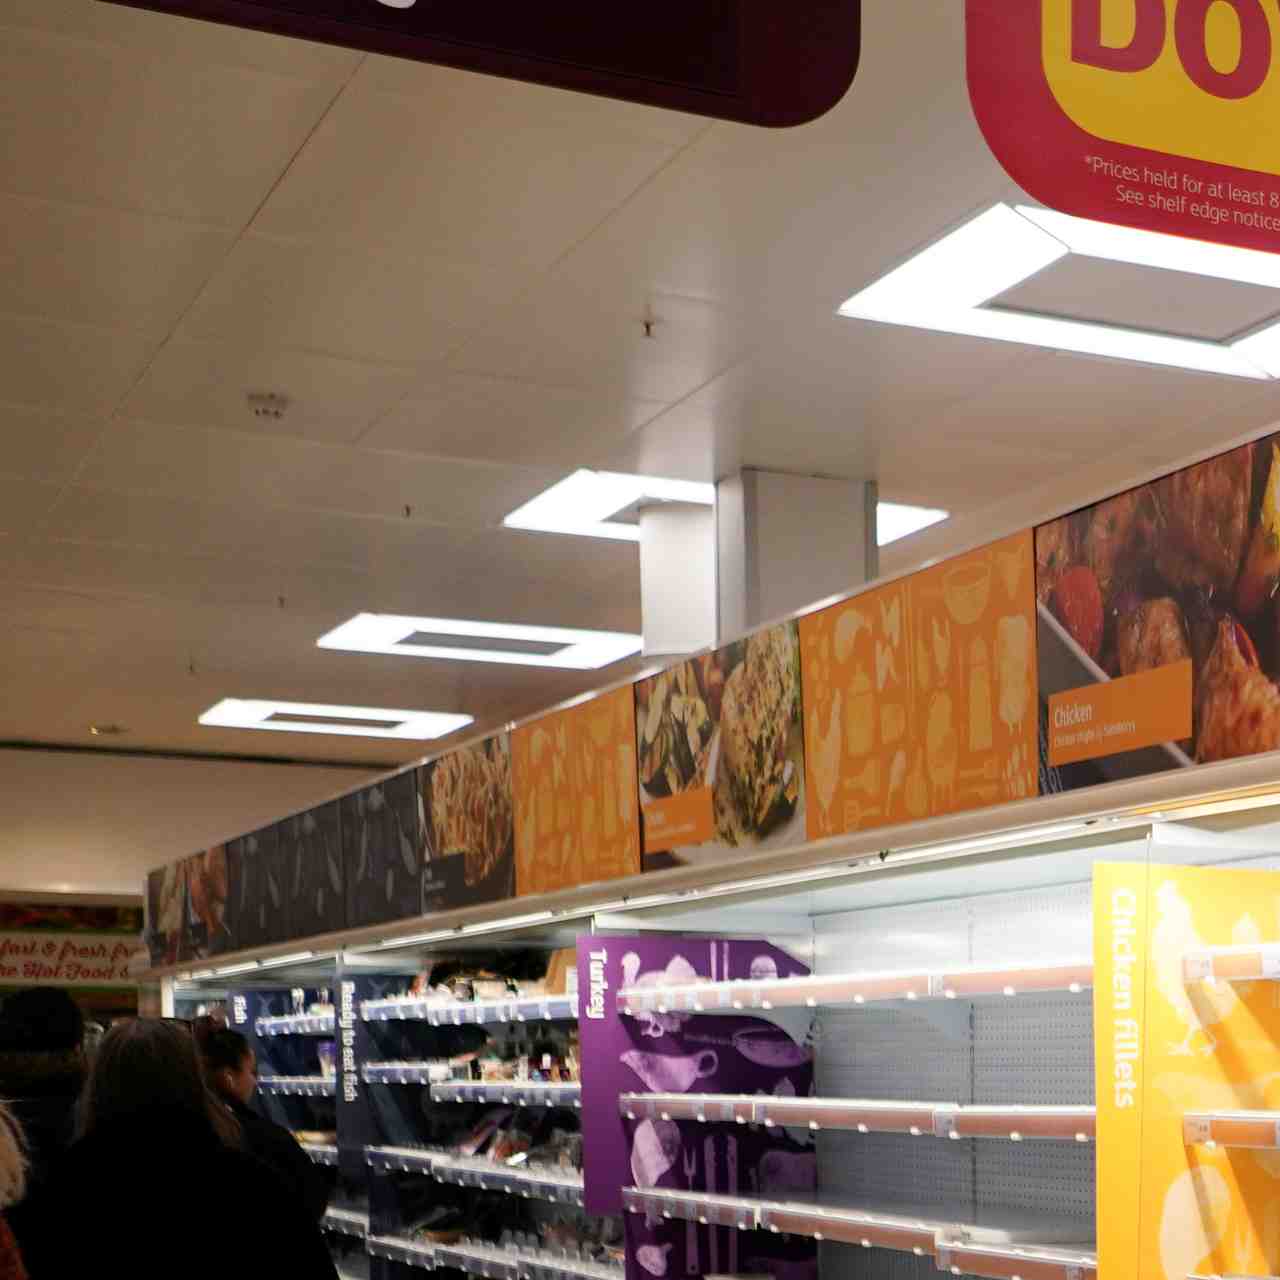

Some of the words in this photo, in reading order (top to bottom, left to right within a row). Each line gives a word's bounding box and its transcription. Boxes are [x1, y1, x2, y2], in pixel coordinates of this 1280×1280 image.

[1116, 185, 1144, 206] See
[1148, 192, 1185, 213] shelf
[1190, 201, 1229, 224] edge
[1144, 167, 1177, 190] held
[1182, 174, 1203, 193] for
[1207, 185, 1223, 199] at
[1228, 183, 1265, 206] least
[1270, 192, 1280, 208] 8
[1054, 702, 1093, 728] Chicken
[1112, 888, 1137, 1009] Chicken
[586, 948, 608, 1019] Turkey
[1113, 1018, 1138, 1109] fillets
